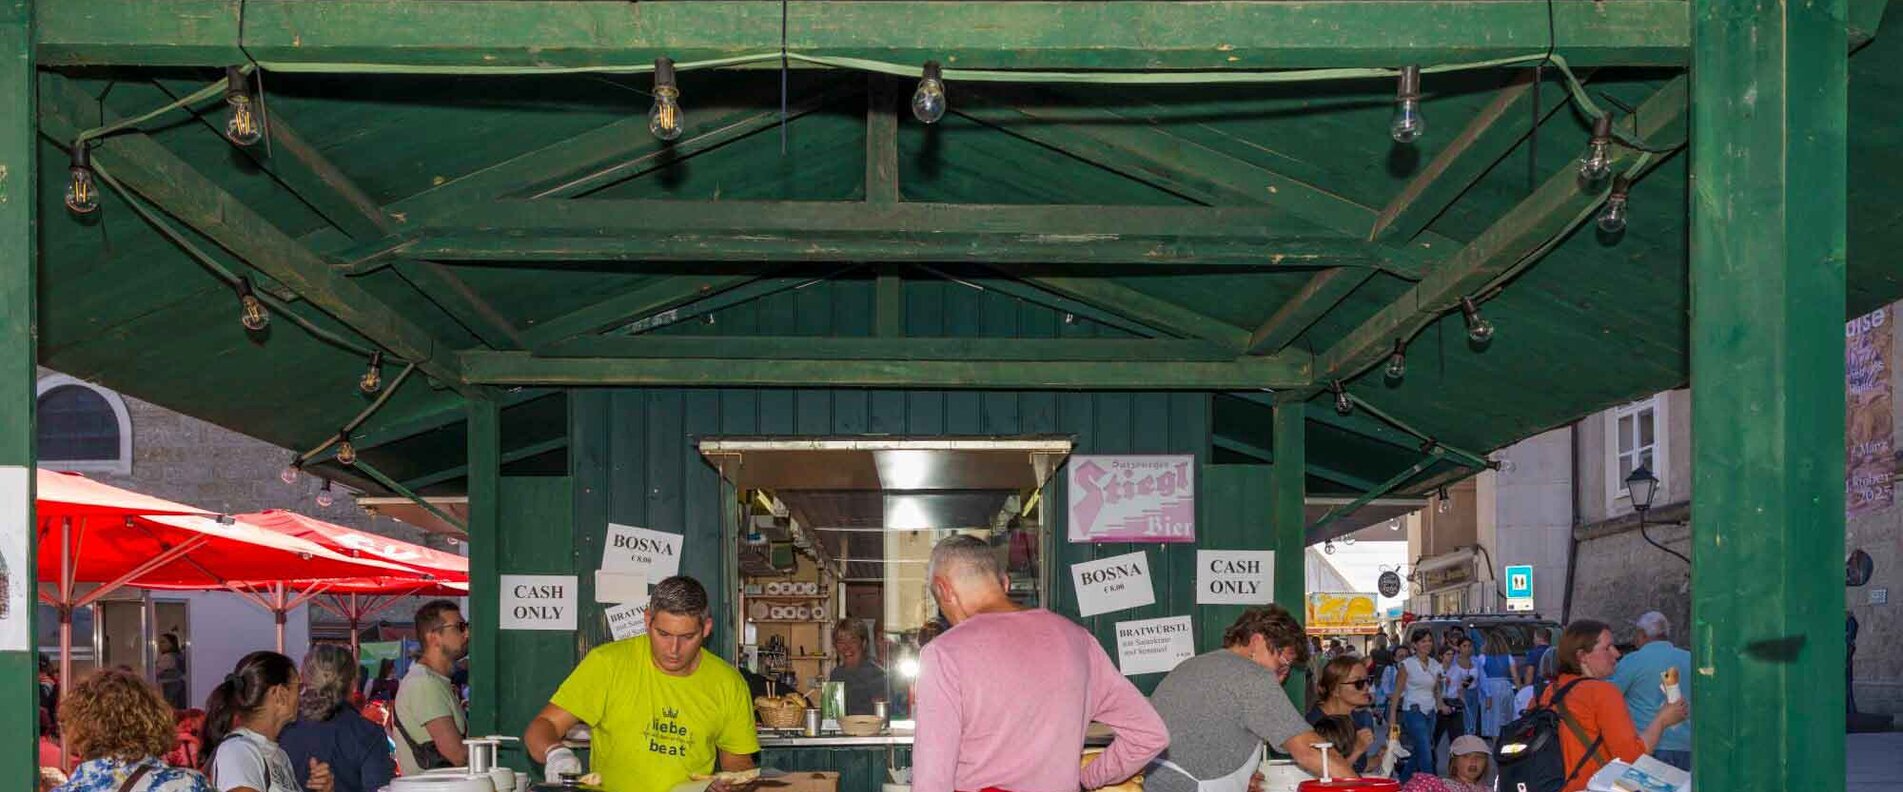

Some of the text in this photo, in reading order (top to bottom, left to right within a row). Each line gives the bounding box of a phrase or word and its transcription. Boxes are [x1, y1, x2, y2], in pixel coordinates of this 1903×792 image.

[1073, 460, 1188, 537] Stiegl
[1144, 515, 1193, 537] Bier
[613, 534, 673, 556] BOSNA
[1081, 562, 1143, 586] BOSNA
[1210, 559, 1260, 574] CASH
[514, 584, 564, 599] CASH
[1210, 580, 1261, 594] ONLY
[513, 606, 564, 620] ONLY
[652, 716, 687, 736] liebe
[649, 738, 686, 757] beat
